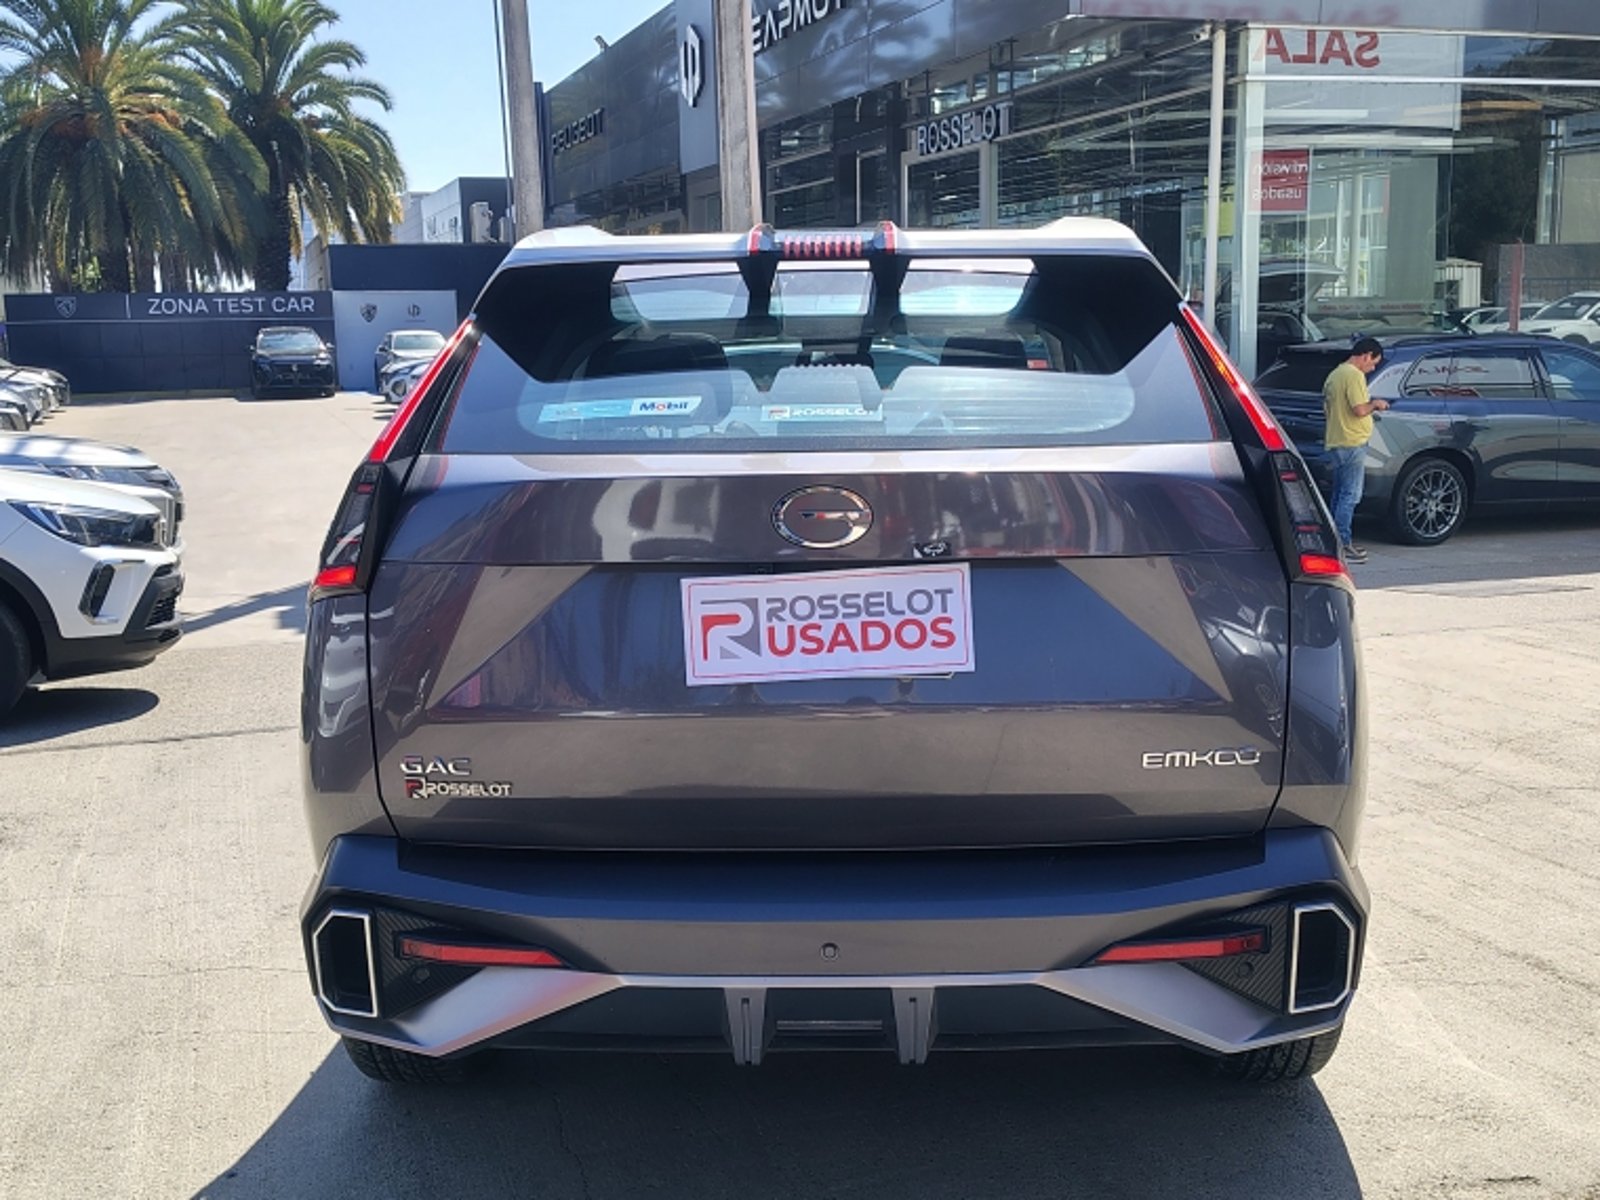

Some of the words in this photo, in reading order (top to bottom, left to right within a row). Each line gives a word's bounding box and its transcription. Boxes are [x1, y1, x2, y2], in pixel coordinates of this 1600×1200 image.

[551, 107, 605, 155] PEUGEOT
[917, 101, 1014, 156] ROSSELOT
[147, 298, 210, 315] ZONA
[212, 297, 266, 315] TEST
[271, 296, 315, 313] CAR
[765, 588, 954, 623] ROSSELOT
[766, 616, 957, 657] USADOS
[400, 755, 472, 776] GAC
[427, 782, 512, 797] ROSSELOT
